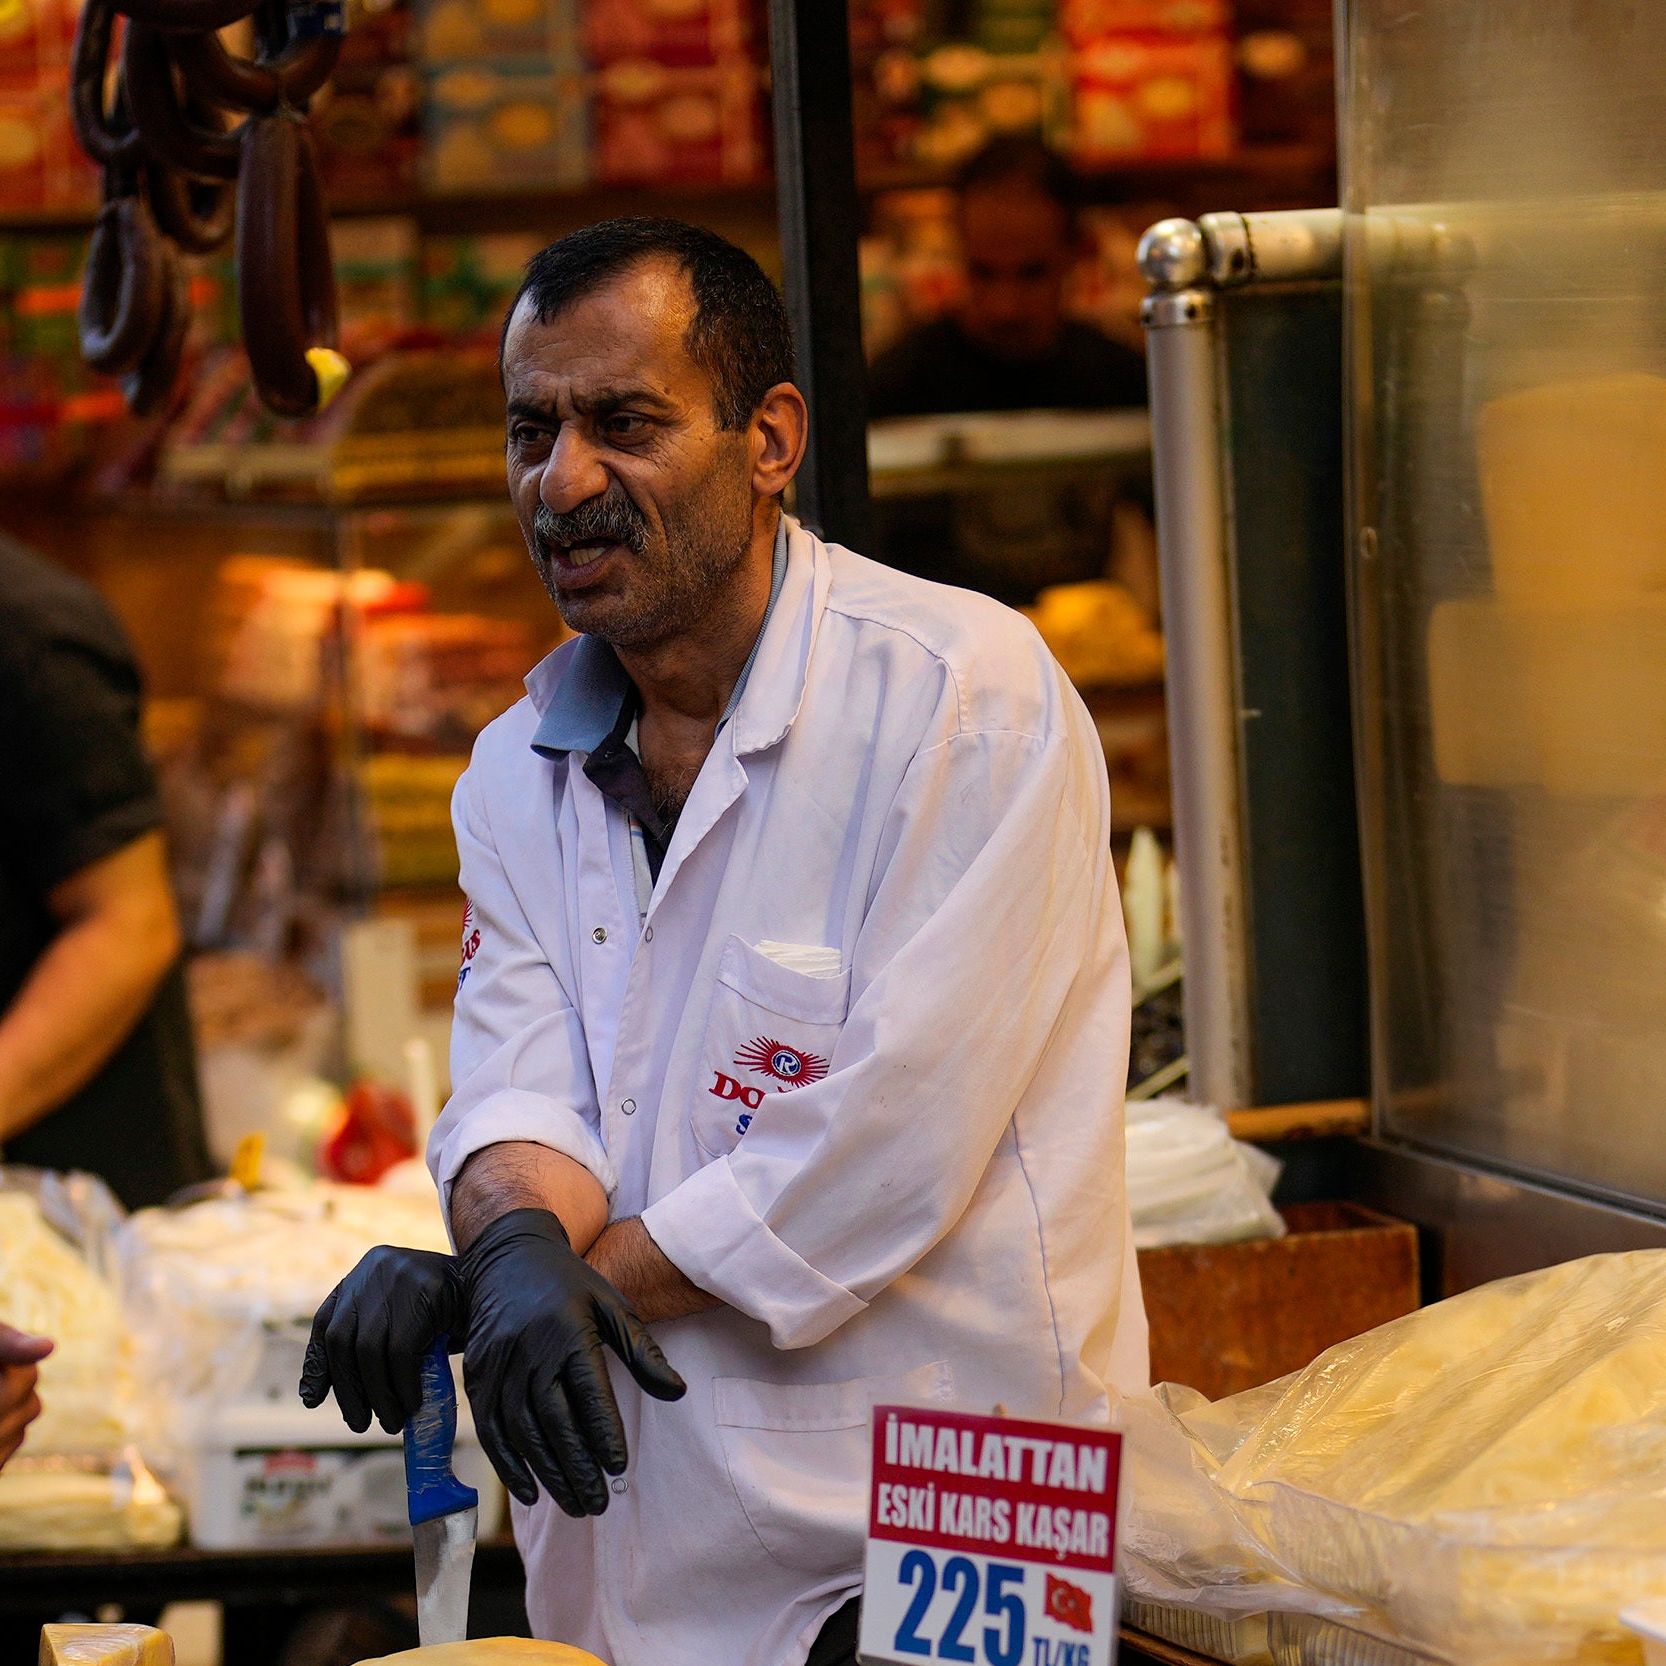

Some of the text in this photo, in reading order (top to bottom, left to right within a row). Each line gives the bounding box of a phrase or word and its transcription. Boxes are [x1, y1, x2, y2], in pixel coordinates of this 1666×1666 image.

[884, 1412, 1109, 1495] İMALATTAN
[876, 1481, 1111, 1561] ESKİ KARS KAŞAR
